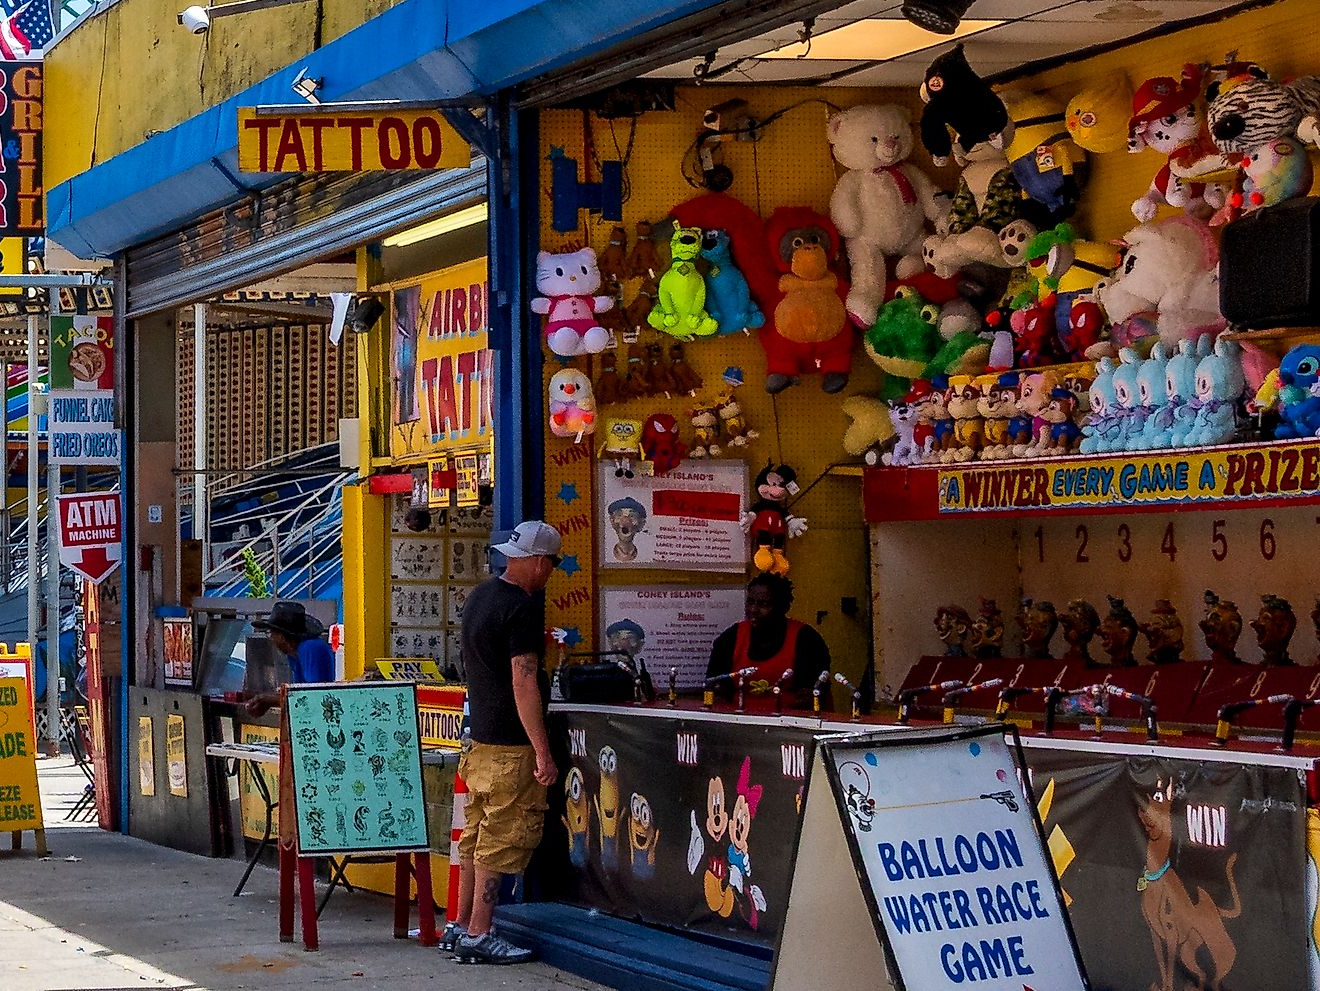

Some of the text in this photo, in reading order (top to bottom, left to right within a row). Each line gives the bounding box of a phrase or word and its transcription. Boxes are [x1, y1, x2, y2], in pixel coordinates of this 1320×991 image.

[11, 66, 43, 229] GRILL
[244, 116, 442, 172] TATTOO
[427, 280, 489, 342] AIRB
[53, 324, 114, 349] TACOS
[52, 397, 91, 423] FUNNEL
[421, 348, 494, 444] TATT
[52, 432, 118, 458] FRIED OREOS
[551, 442, 591, 467] WIN
[945, 447, 1320, 509] A WINNER EVERY GAME A PRIZE
[66, 498, 117, 528] ATM
[68, 527, 117, 542] MACHINE
[1034, 518, 1276, 563] 1 2 3 4 5 6
[552, 587, 591, 611] WIN
[391, 662, 421, 673] PAY
[1009, 663, 1024, 688] 3
[1249, 670, 1268, 698] 8
[420, 711, 460, 741] TATTOOS
[567, 728, 588, 757] WIN
[676, 733, 698, 765] WIN
[779, 744, 805, 778] WIN
[1186, 804, 1226, 847] WIN
[877, 828, 1024, 882] BALLOON
[883, 879, 1050, 935] WATER RACE
[940, 935, 1035, 984] GAME
